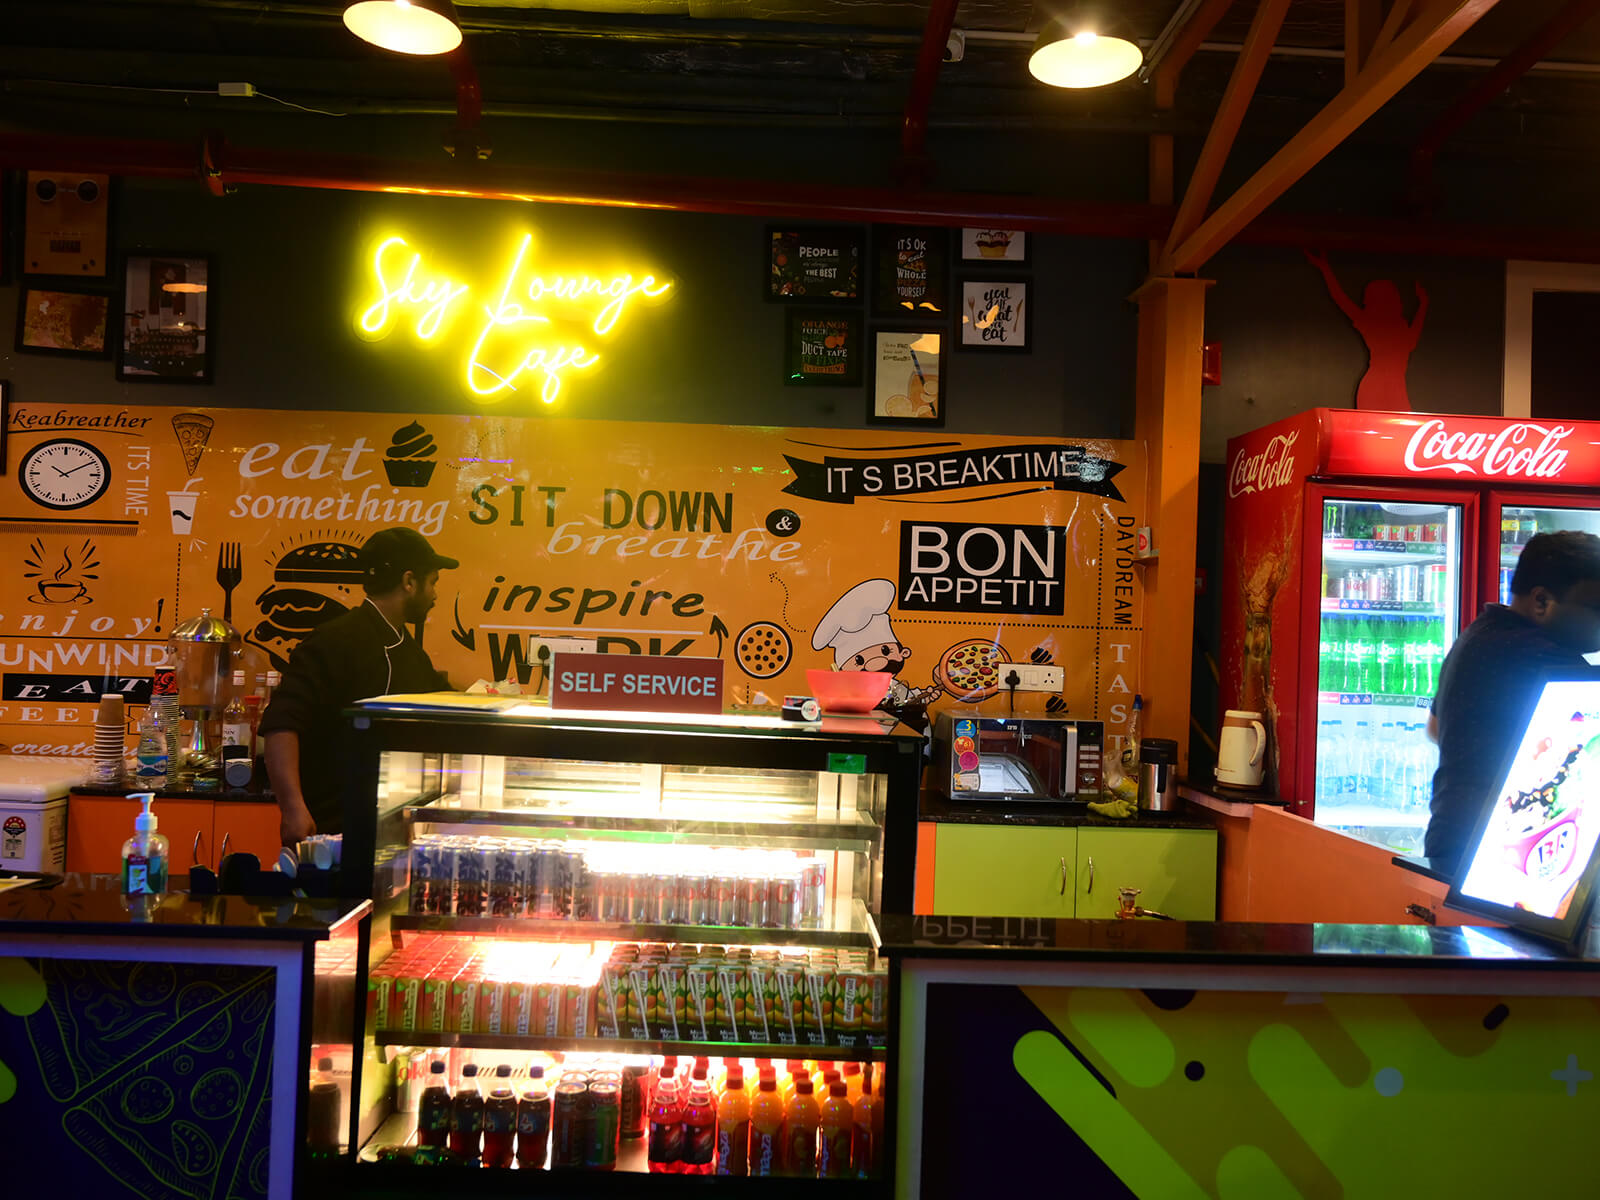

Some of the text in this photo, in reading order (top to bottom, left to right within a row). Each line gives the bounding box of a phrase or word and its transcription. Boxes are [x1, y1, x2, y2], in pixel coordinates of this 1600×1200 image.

[799, 245, 840, 258] PEOPLE
[360, 231, 673, 339] Sky Lounge
[819, 267, 839, 279] BEST
[896, 266, 927, 280] WHOLE
[801, 340, 825, 355] DUCT
[826, 349, 848, 358] TAPE
[982, 327, 1008, 342] eat
[238, 437, 375, 481] eat
[1229, 428, 1300, 499] Coca-Cola
[1403, 419, 1575, 478] Coca-Cola
[826, 467, 854, 494] IT
[893, 450, 1082, 490] BREAKTIME
[124, 476, 150, 516] TIME
[229, 484, 449, 537] something
[468, 484, 734, 533] SIT DOWN
[547, 521, 802, 562] breathe
[775, 515, 793, 531] &
[909, 525, 1055, 578] BON
[1114, 515, 1135, 626] DAYDREAM
[483, 575, 705, 625] inspire
[904, 575, 1060, 607] APPETIT
[0, 599, 165, 638] njoy!
[0, 643, 169, 672] UNWIND
[13, 678, 151, 700] EAT
[560, 671, 717, 697] SELF SERVICE
